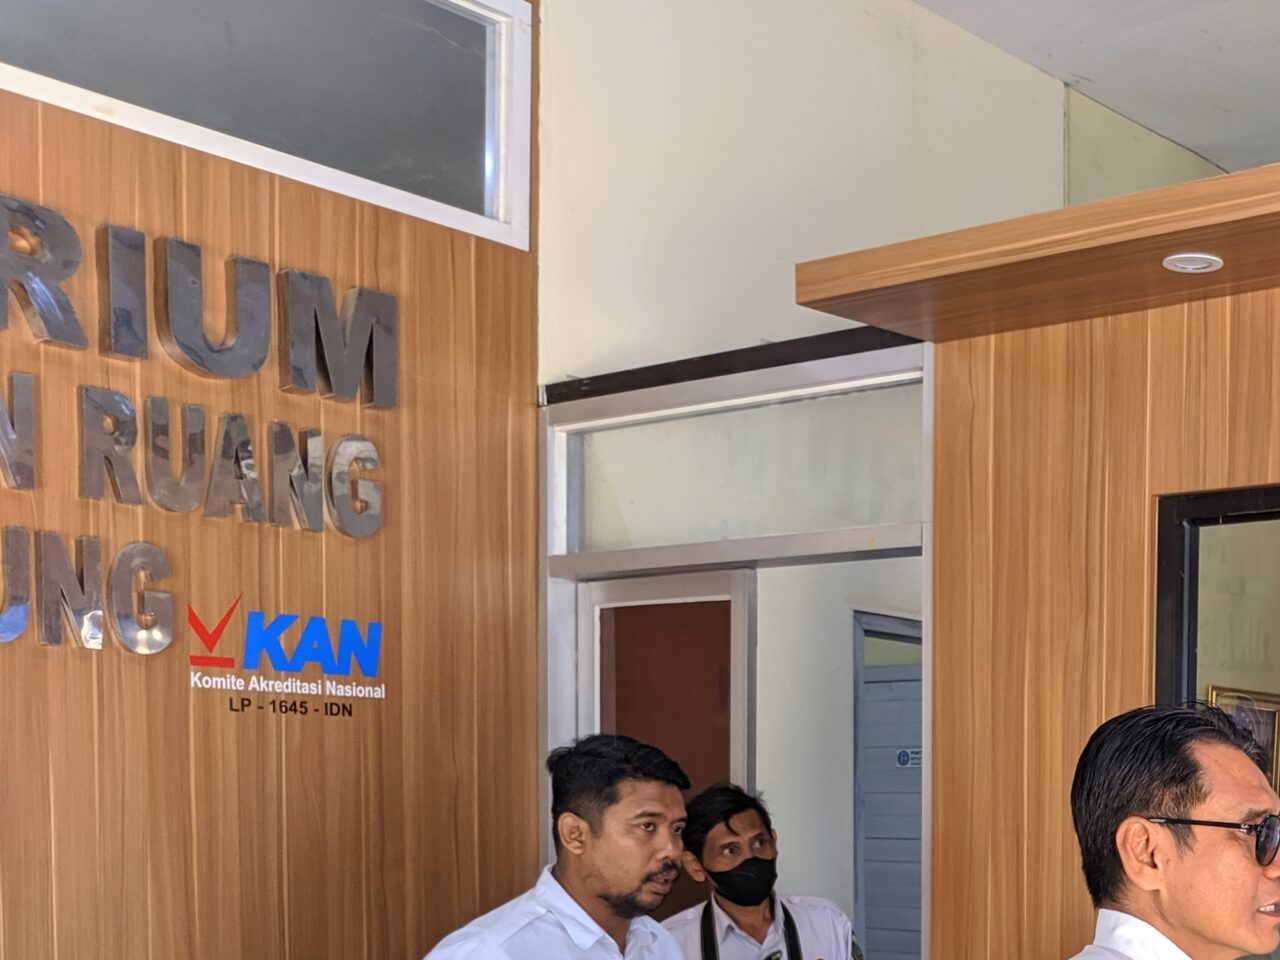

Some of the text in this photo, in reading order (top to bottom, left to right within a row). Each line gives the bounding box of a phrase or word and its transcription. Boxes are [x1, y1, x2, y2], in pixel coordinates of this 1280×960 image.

[77, 384, 385, 538] RUANG
[242, 611, 382, 678] KAN
[190, 671, 386, 699] Komite Akreditasi Nasional
[229, 698, 251, 712] LP
[269, 700, 308, 715] 1645
[324, 702, 353, 717] IDN
